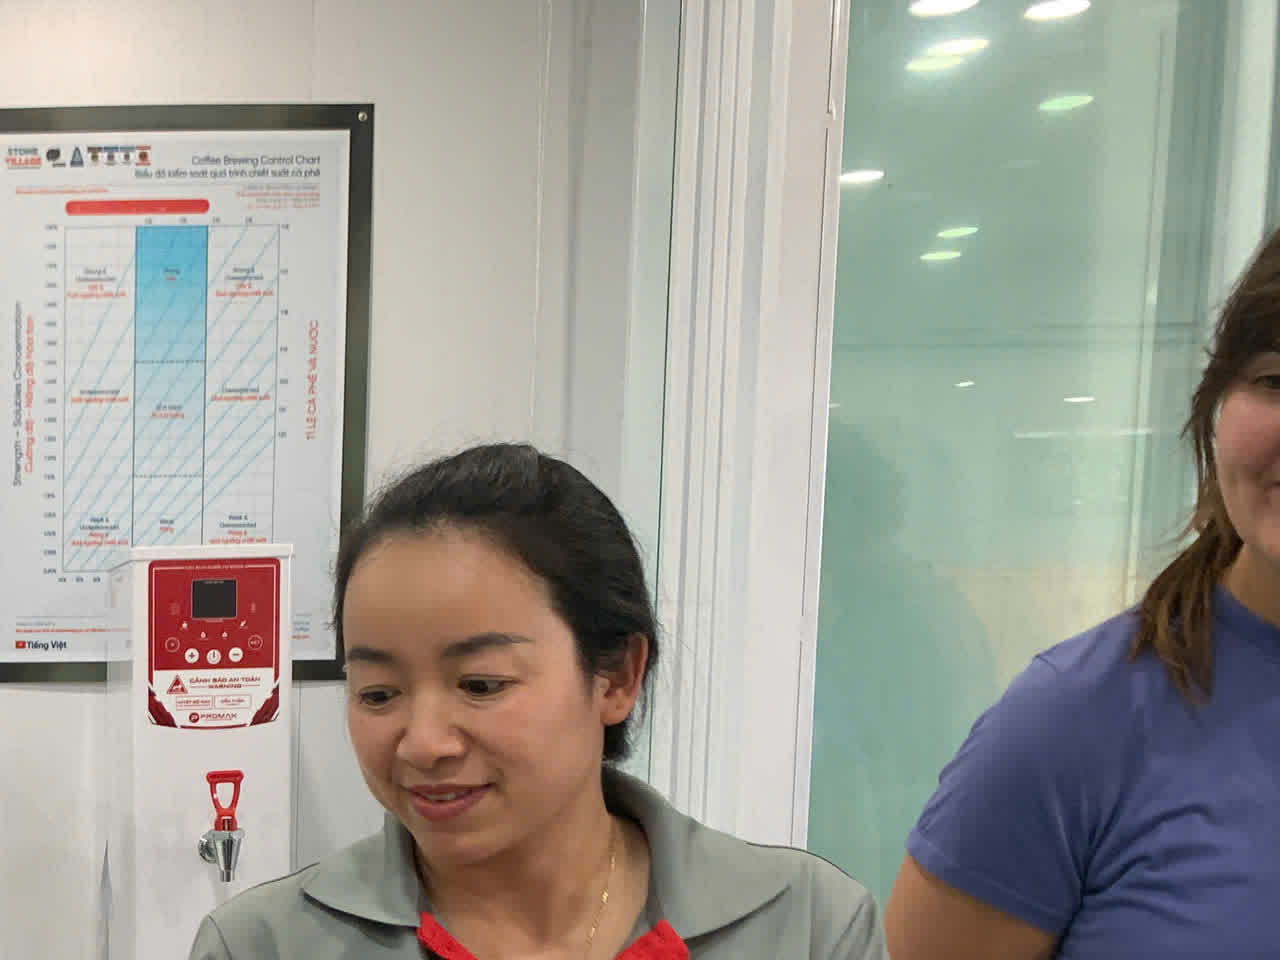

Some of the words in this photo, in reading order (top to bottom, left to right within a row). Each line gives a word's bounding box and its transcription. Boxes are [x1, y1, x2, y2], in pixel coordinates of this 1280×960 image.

[261, 155, 293, 165] Control
[295, 154, 320, 165] Chart
[27, 640, 48, 651] Tiếng
[51, 640, 67, 651] Việt
